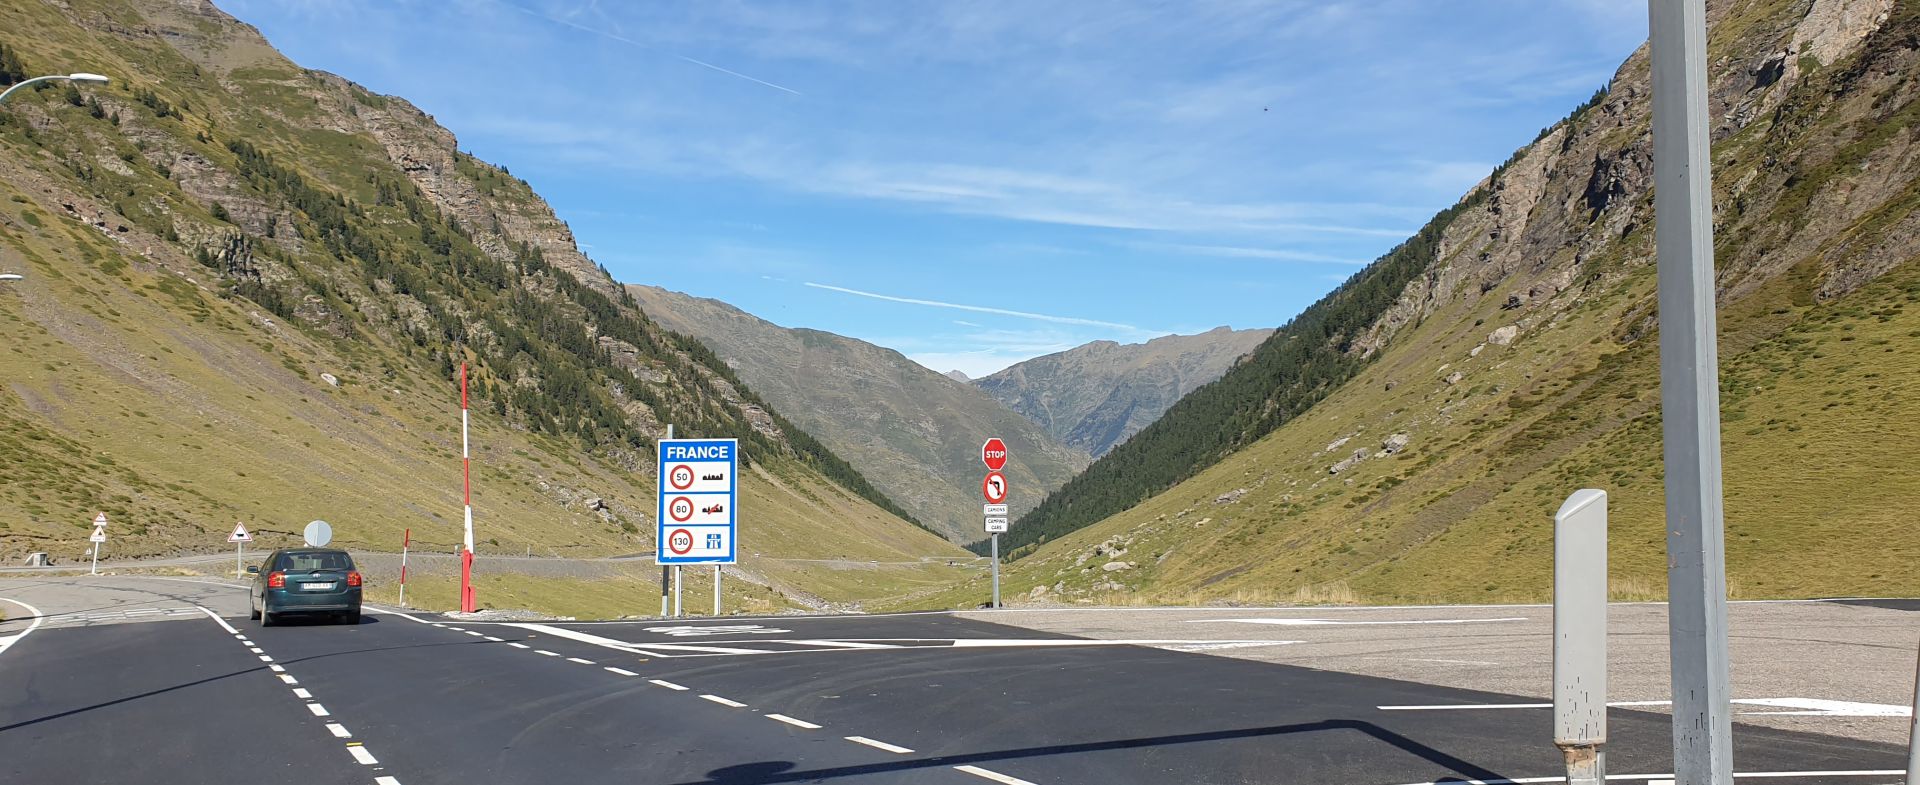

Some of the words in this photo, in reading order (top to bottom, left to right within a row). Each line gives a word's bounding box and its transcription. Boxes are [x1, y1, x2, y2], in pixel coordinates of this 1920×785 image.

[667, 446, 729, 459] FRANCE
[986, 451, 1005, 459] STOP
[676, 473, 688, 481] 50
[676, 505, 687, 514] 80
[673, 537, 689, 546] 130
